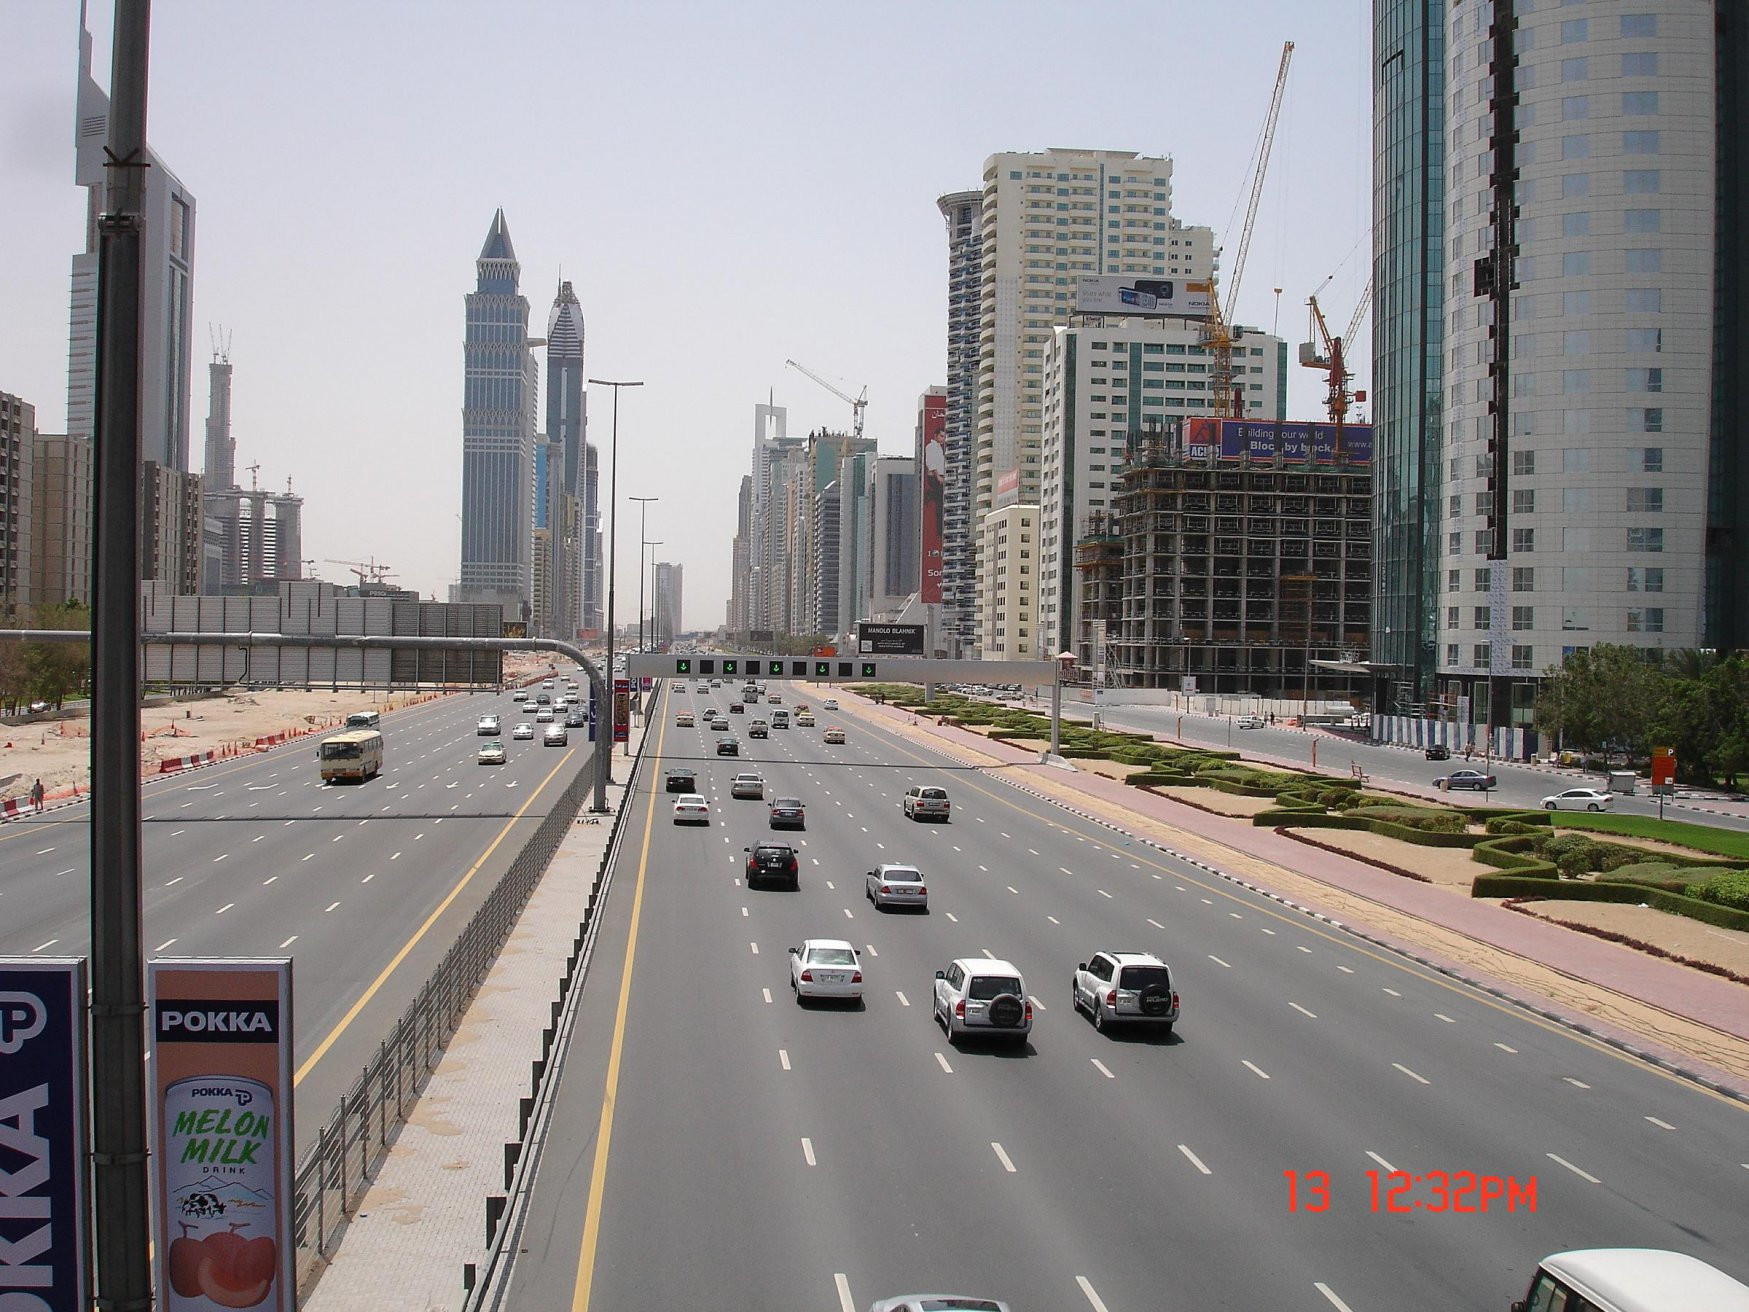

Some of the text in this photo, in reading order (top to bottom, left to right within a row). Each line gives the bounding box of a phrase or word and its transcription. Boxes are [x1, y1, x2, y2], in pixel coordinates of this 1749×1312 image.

[1238, 427, 1274, 440] Bilding
[1250, 441, 1275, 450] Bloc
[1284, 442, 1298, 453] by
[1668, 748, 1674, 756] P
[161, 1010, 272, 1033] POKKA
[192, 1087, 233, 1098] POKKA
[172, 1108, 270, 1140] MELON
[180, 1137, 262, 1165] MILK
[203, 1166, 246, 1175] DRINK
